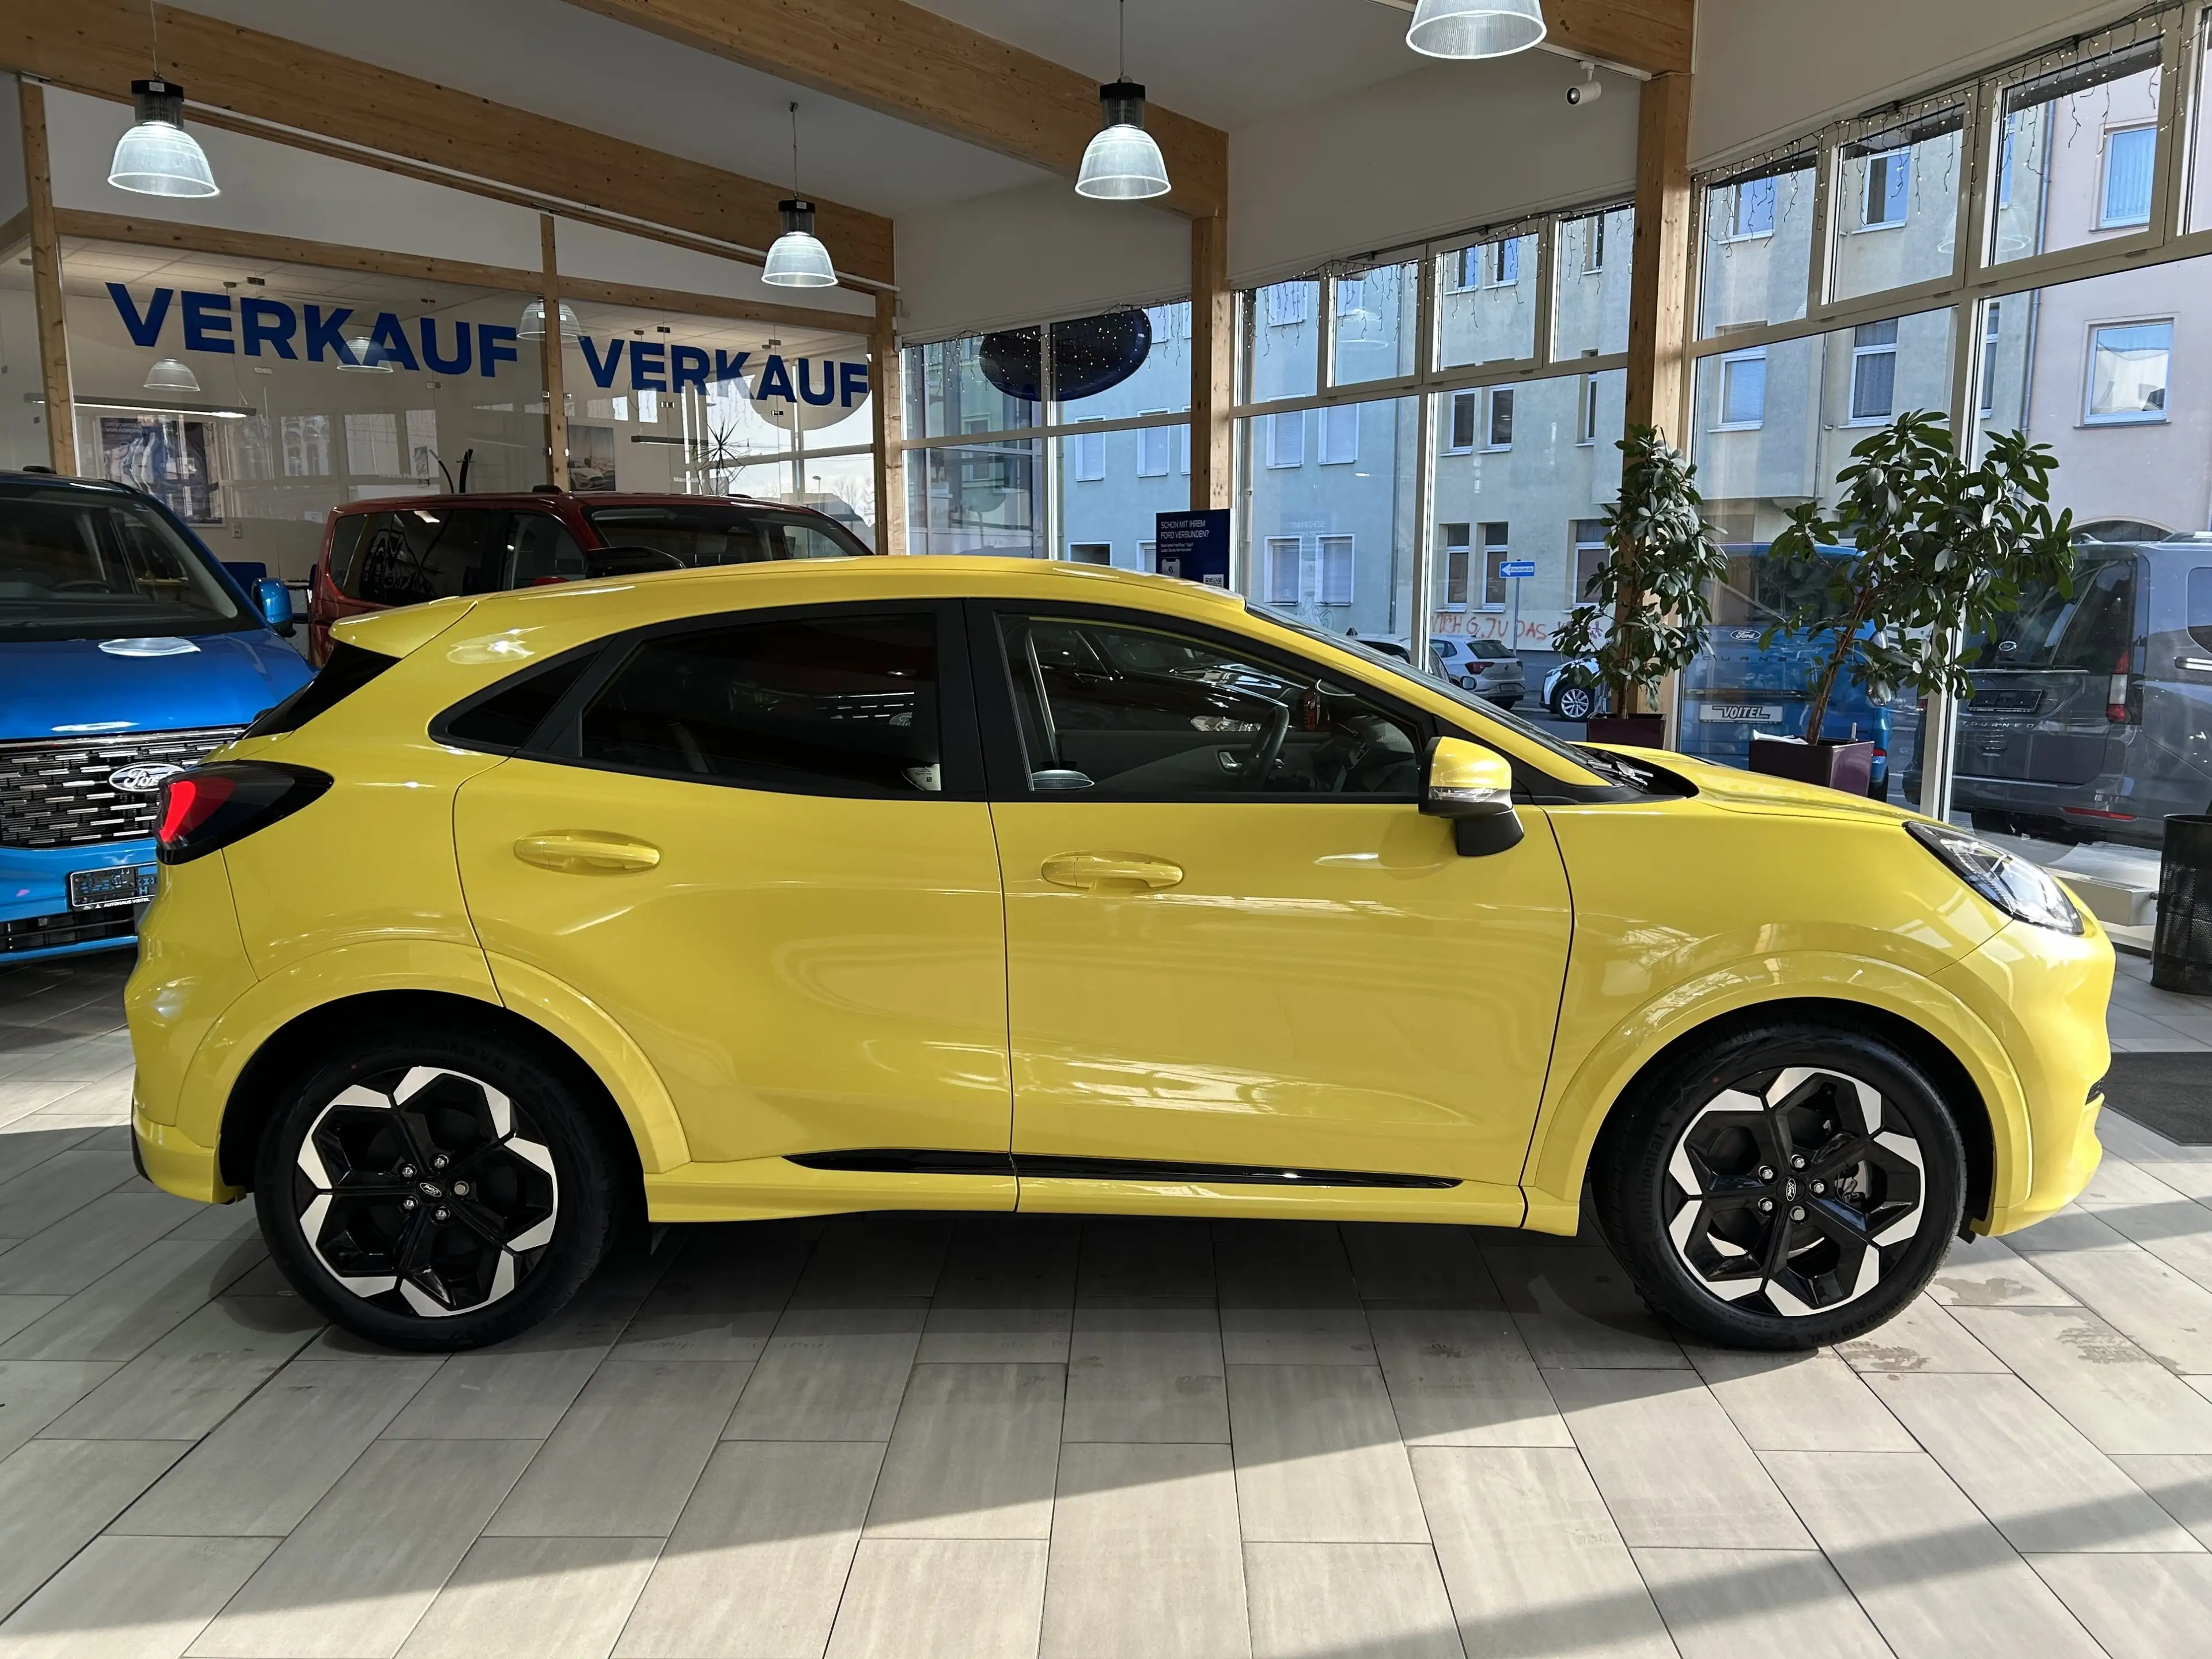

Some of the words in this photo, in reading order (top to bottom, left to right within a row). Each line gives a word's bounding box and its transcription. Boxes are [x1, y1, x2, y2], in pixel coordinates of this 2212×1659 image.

[105, 282, 518, 377] VERKAUF
[578, 335, 868, 407] VERKAUF
[1161, 521, 1179, 529] SCHON
[1179, 520, 1188, 528] MIT
[1189, 520, 1206, 528] IHREM
[1161, 531, 1175, 539] FORD
[1175, 530, 1210, 539] VERBUNDEN?
[1714, 706, 1770, 719] VOITEL
[104, 900, 132, 908] AUTOHAUS
